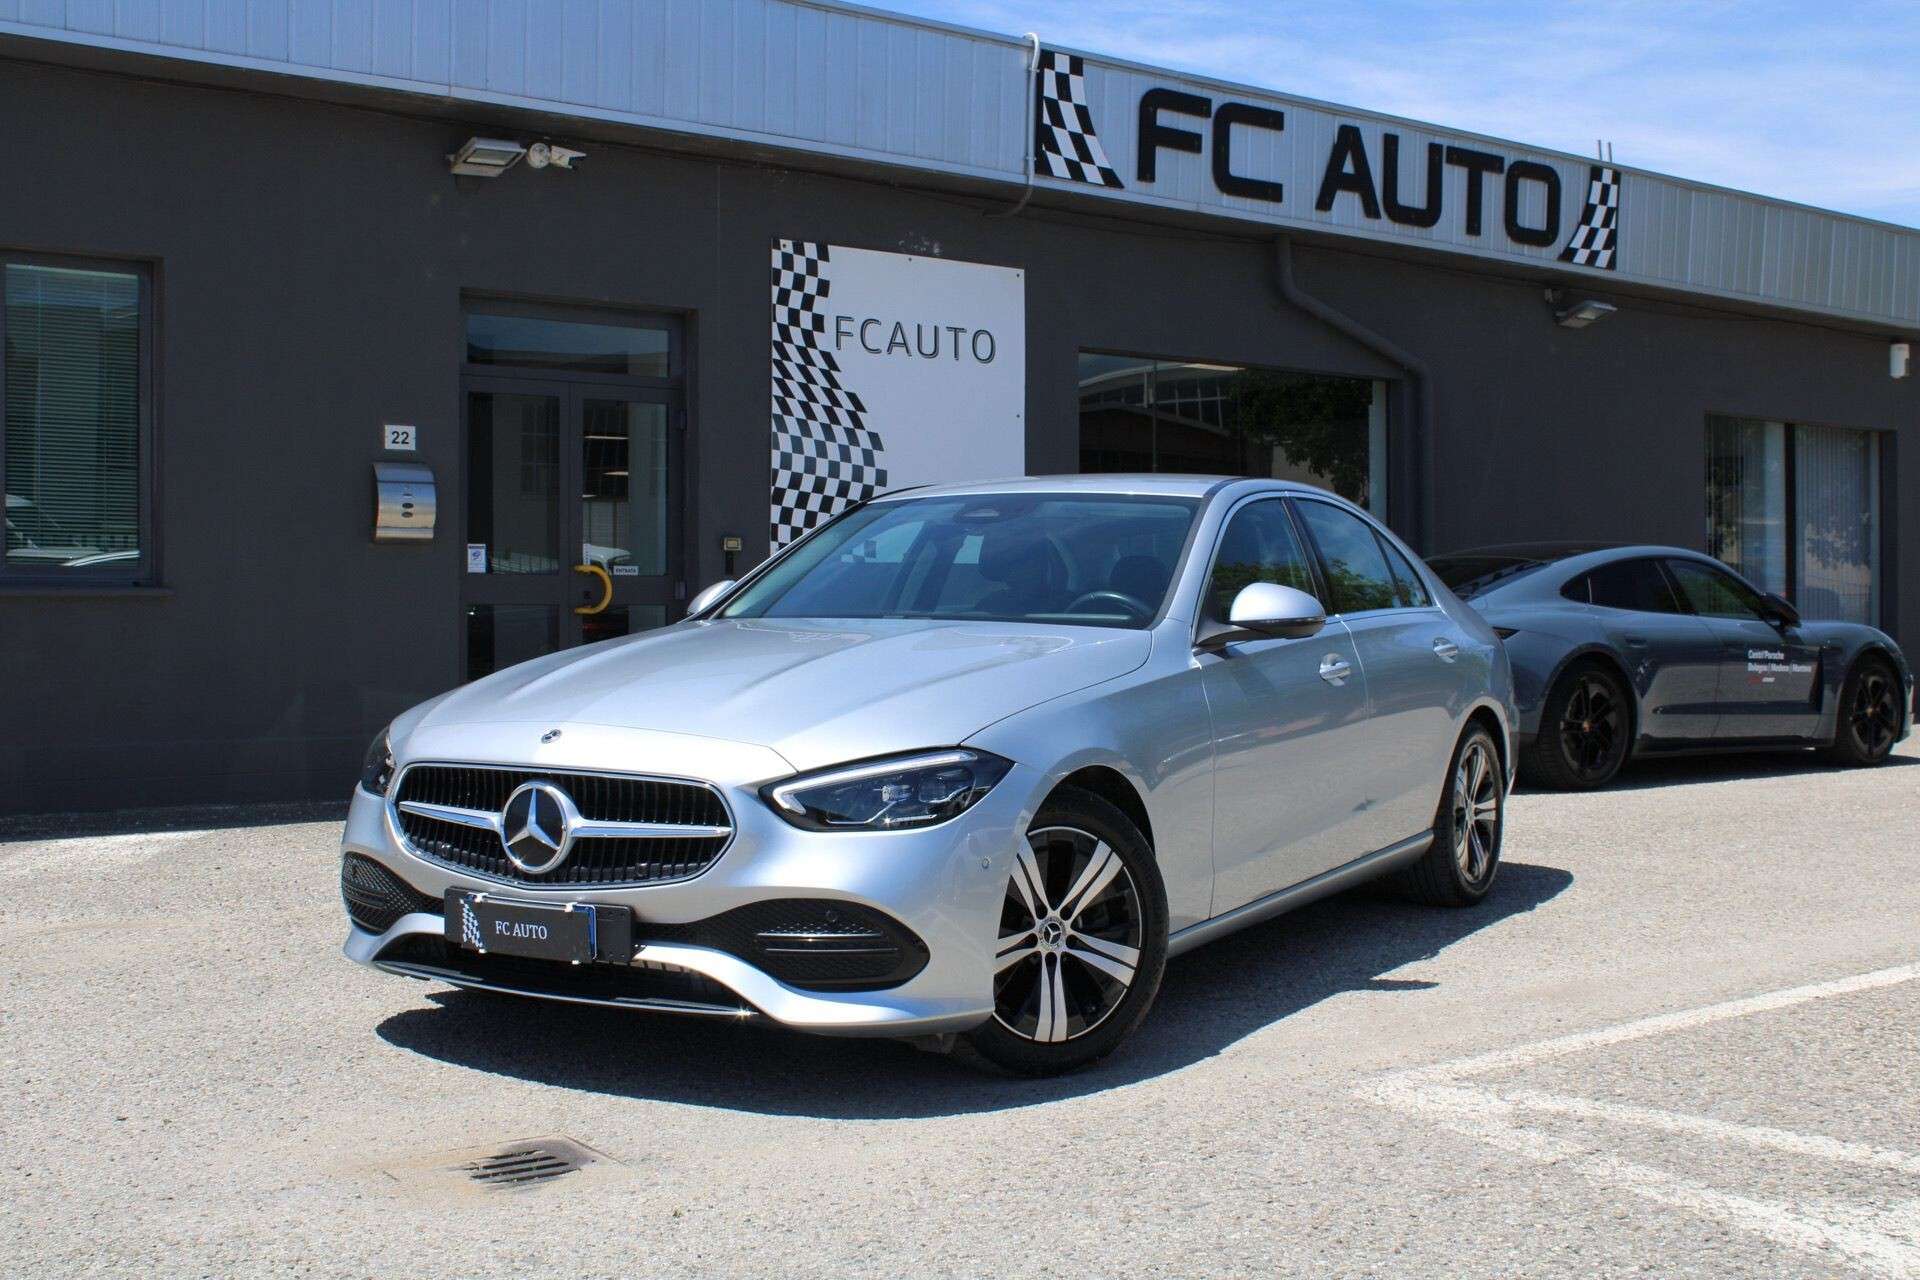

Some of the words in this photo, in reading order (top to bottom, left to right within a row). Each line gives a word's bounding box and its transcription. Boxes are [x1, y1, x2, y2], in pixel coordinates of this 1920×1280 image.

[1137, 88, 1284, 202] FC
[1315, 125, 1561, 247] AUTO
[835, 316, 996, 364] FCAUTO
[391, 430, 410, 445] 22
[495, 920, 510, 936] FC
[512, 923, 548, 940] AUTO
